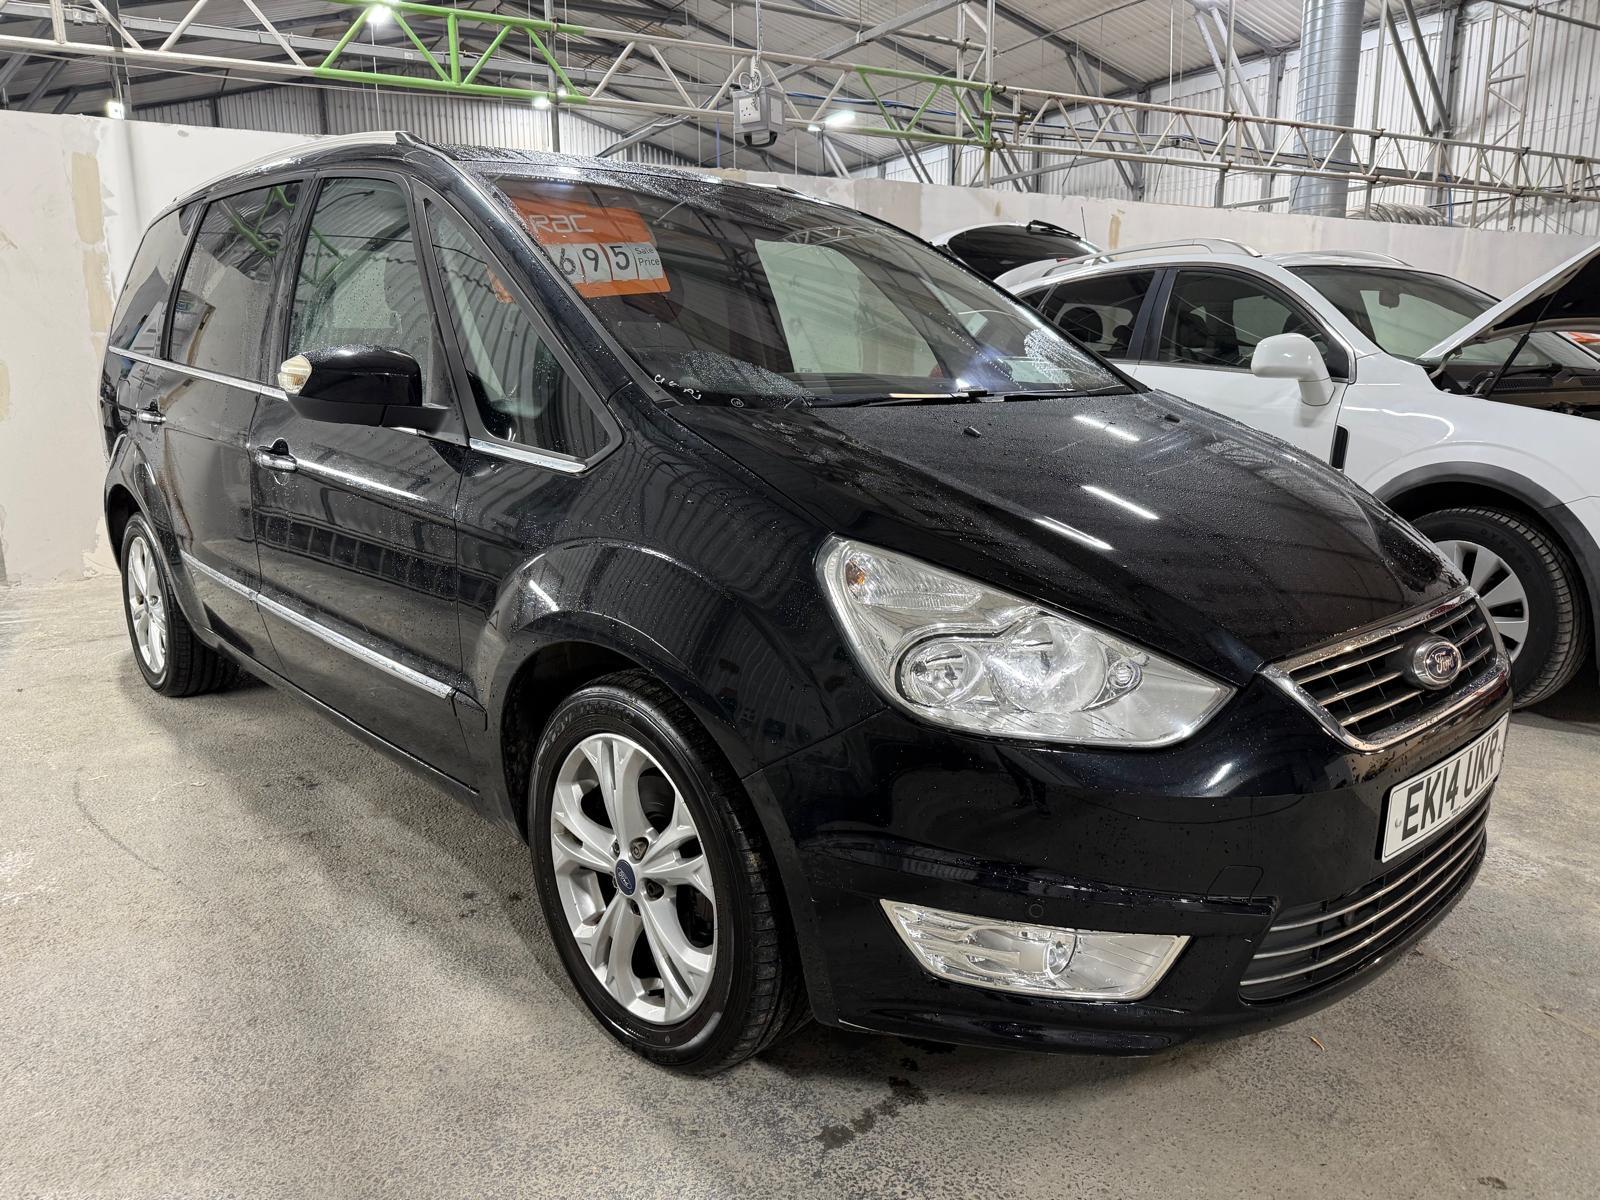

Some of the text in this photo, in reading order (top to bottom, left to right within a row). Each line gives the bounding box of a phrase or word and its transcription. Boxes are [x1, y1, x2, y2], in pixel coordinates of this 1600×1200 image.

[634, 247, 655, 255] Sale
[638, 257, 661, 267] Price
[1434, 650, 1455, 674] Ford
[1401, 729, 1499, 841] EK14 UKR
